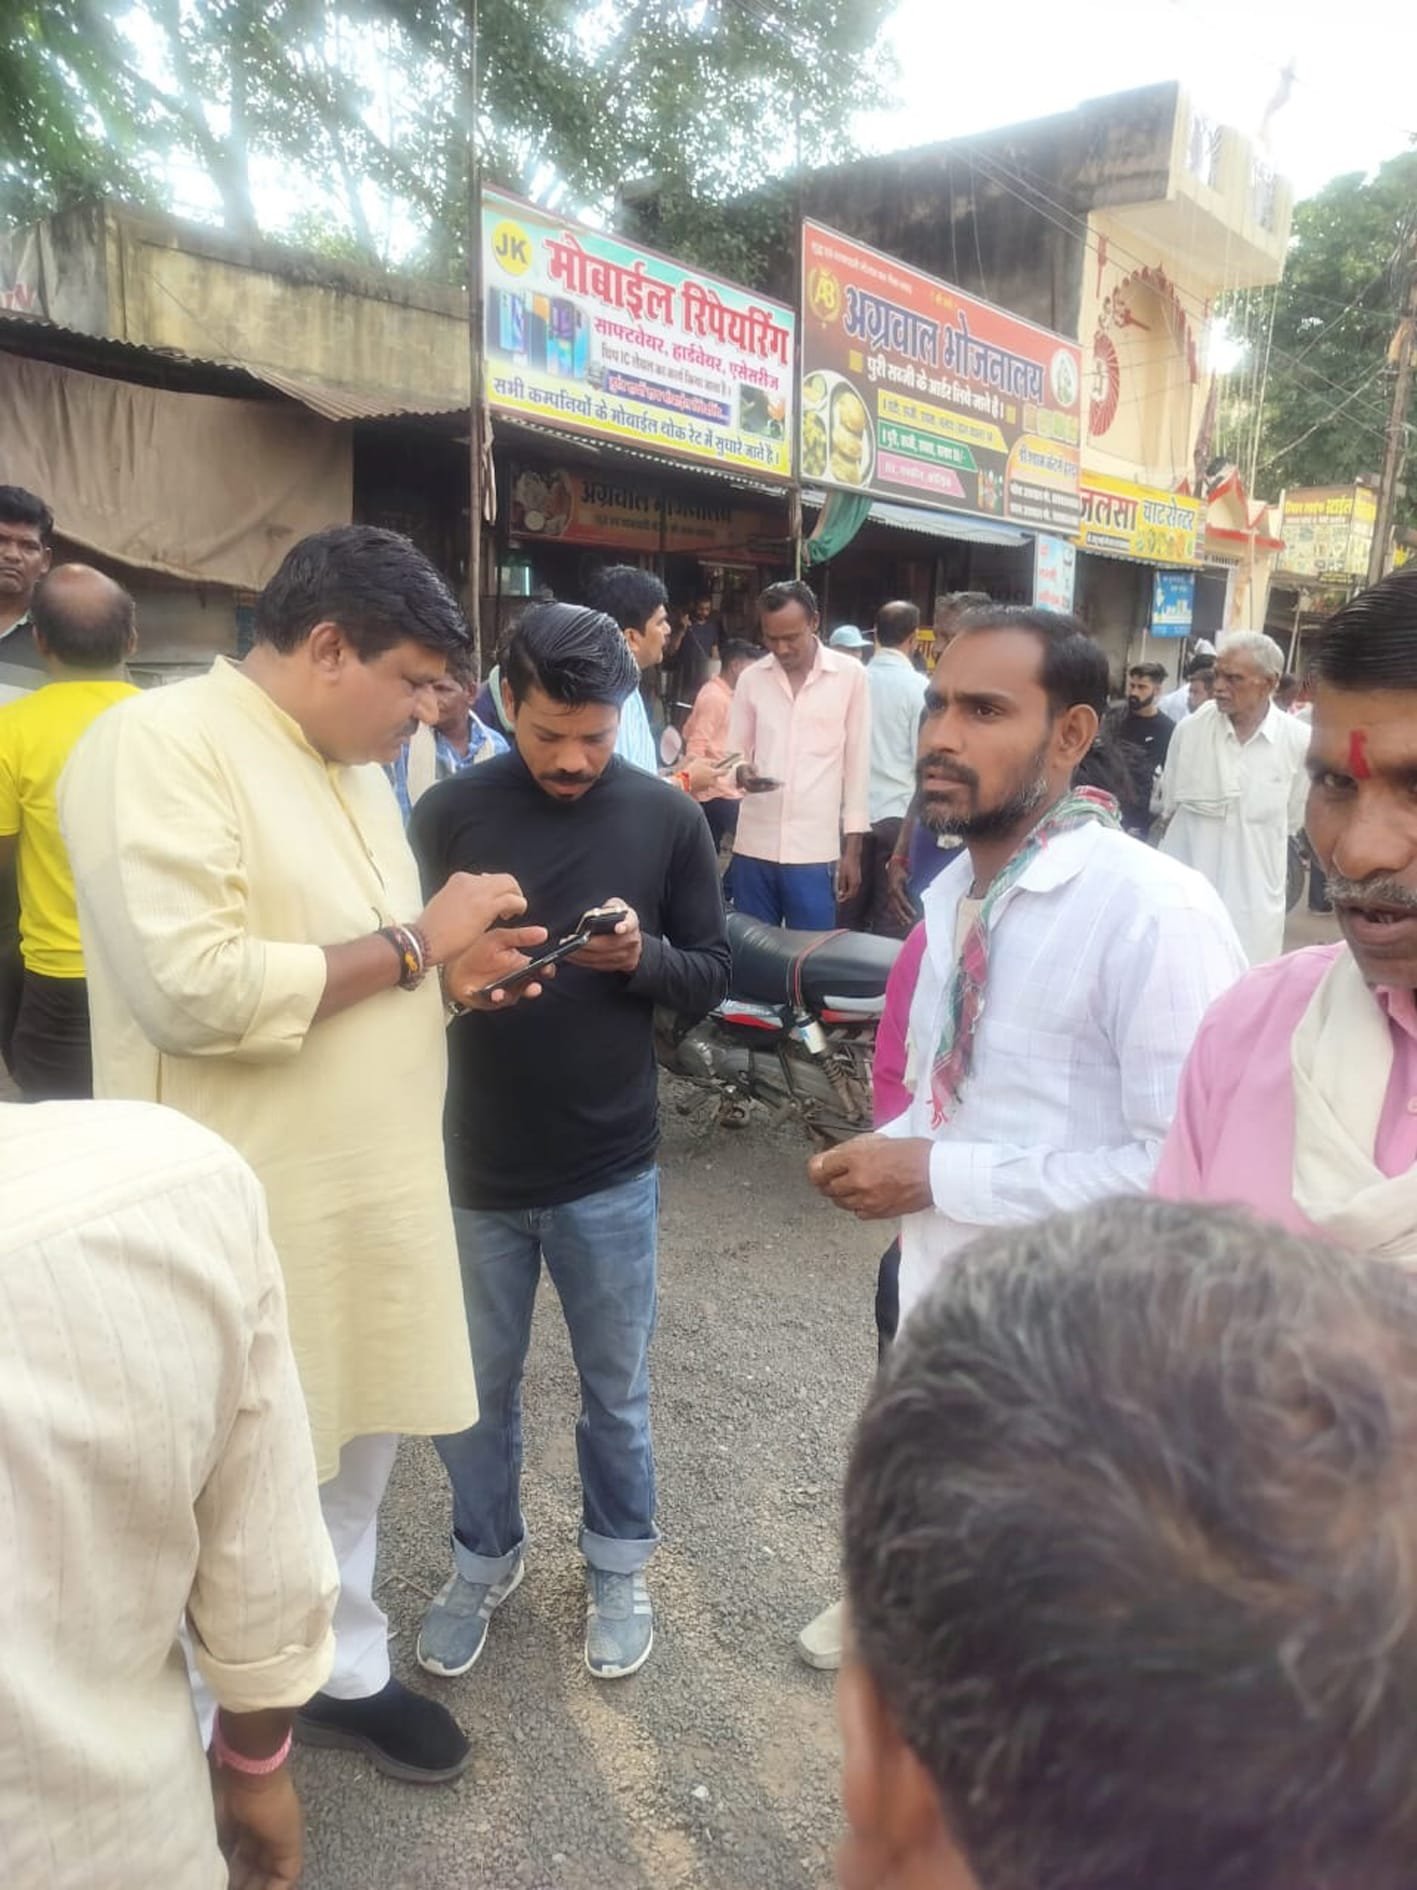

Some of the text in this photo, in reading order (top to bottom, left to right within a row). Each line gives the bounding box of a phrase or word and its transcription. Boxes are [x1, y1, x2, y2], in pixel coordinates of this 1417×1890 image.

[495, 234, 528, 264] JK
[544, 232, 789, 365] मोबाईल रिपेयरिंग
[844, 285, 1045, 404] अग्रवाल भोजनालय
[494, 376, 524, 399] सभी
[595, 399, 608, 420] के
[661, 418, 686, 441] थोक
[688, 423, 702, 445] रेट
